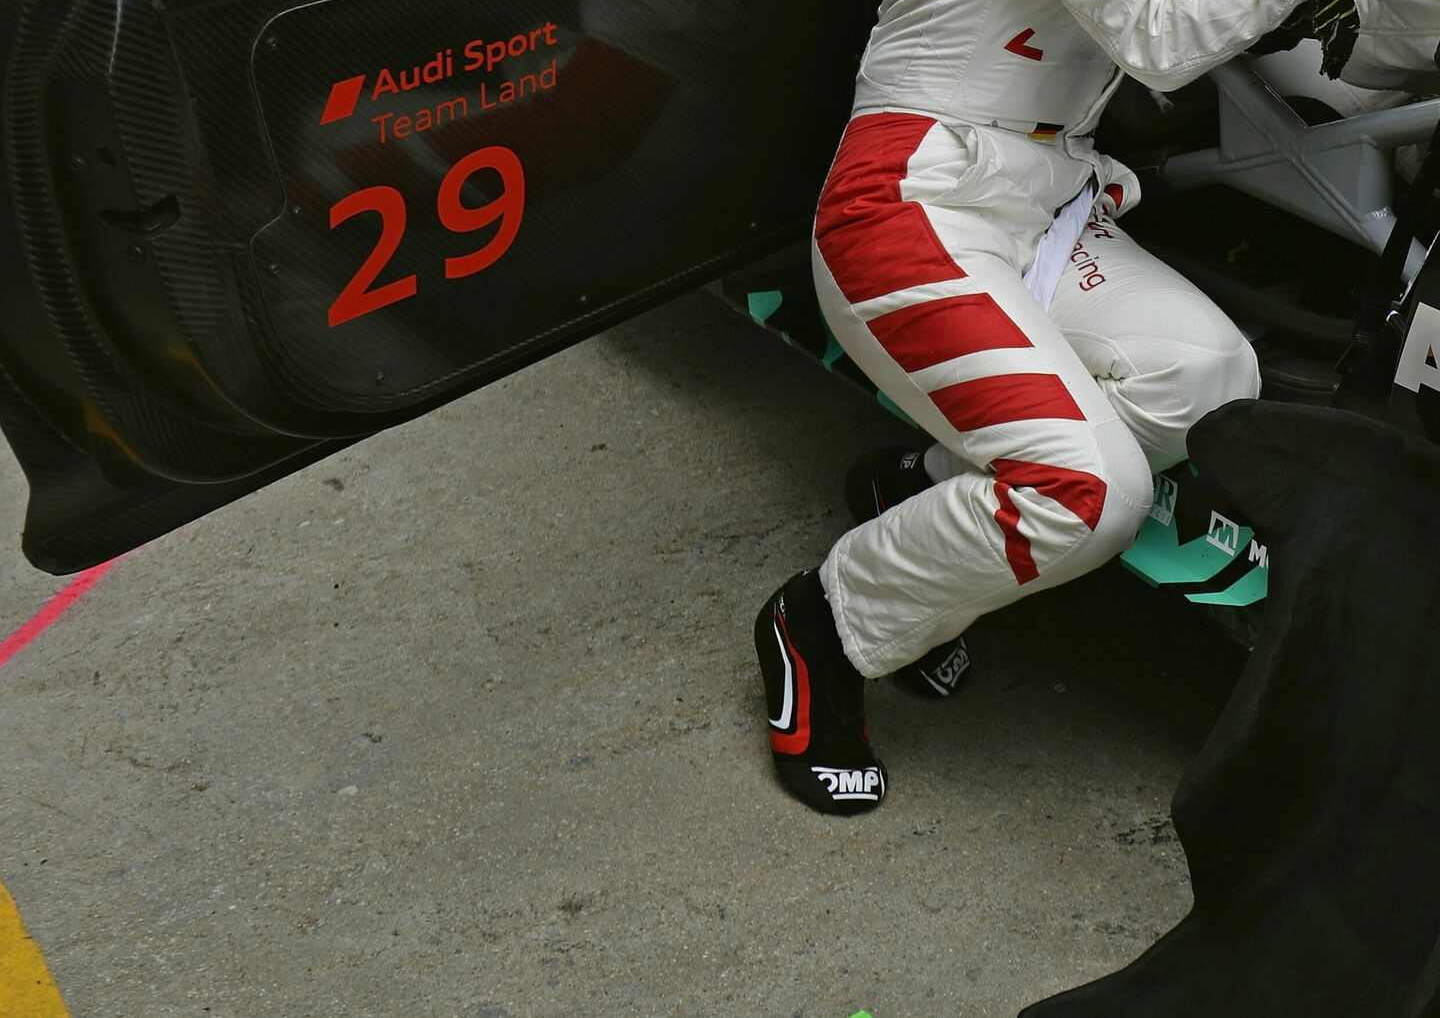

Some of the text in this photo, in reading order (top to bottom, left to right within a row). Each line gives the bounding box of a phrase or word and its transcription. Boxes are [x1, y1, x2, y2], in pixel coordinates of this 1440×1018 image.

[371, 21, 558, 101] Audi Sport
[372, 60, 558, 144] Team Land
[328, 145, 526, 329] 29
